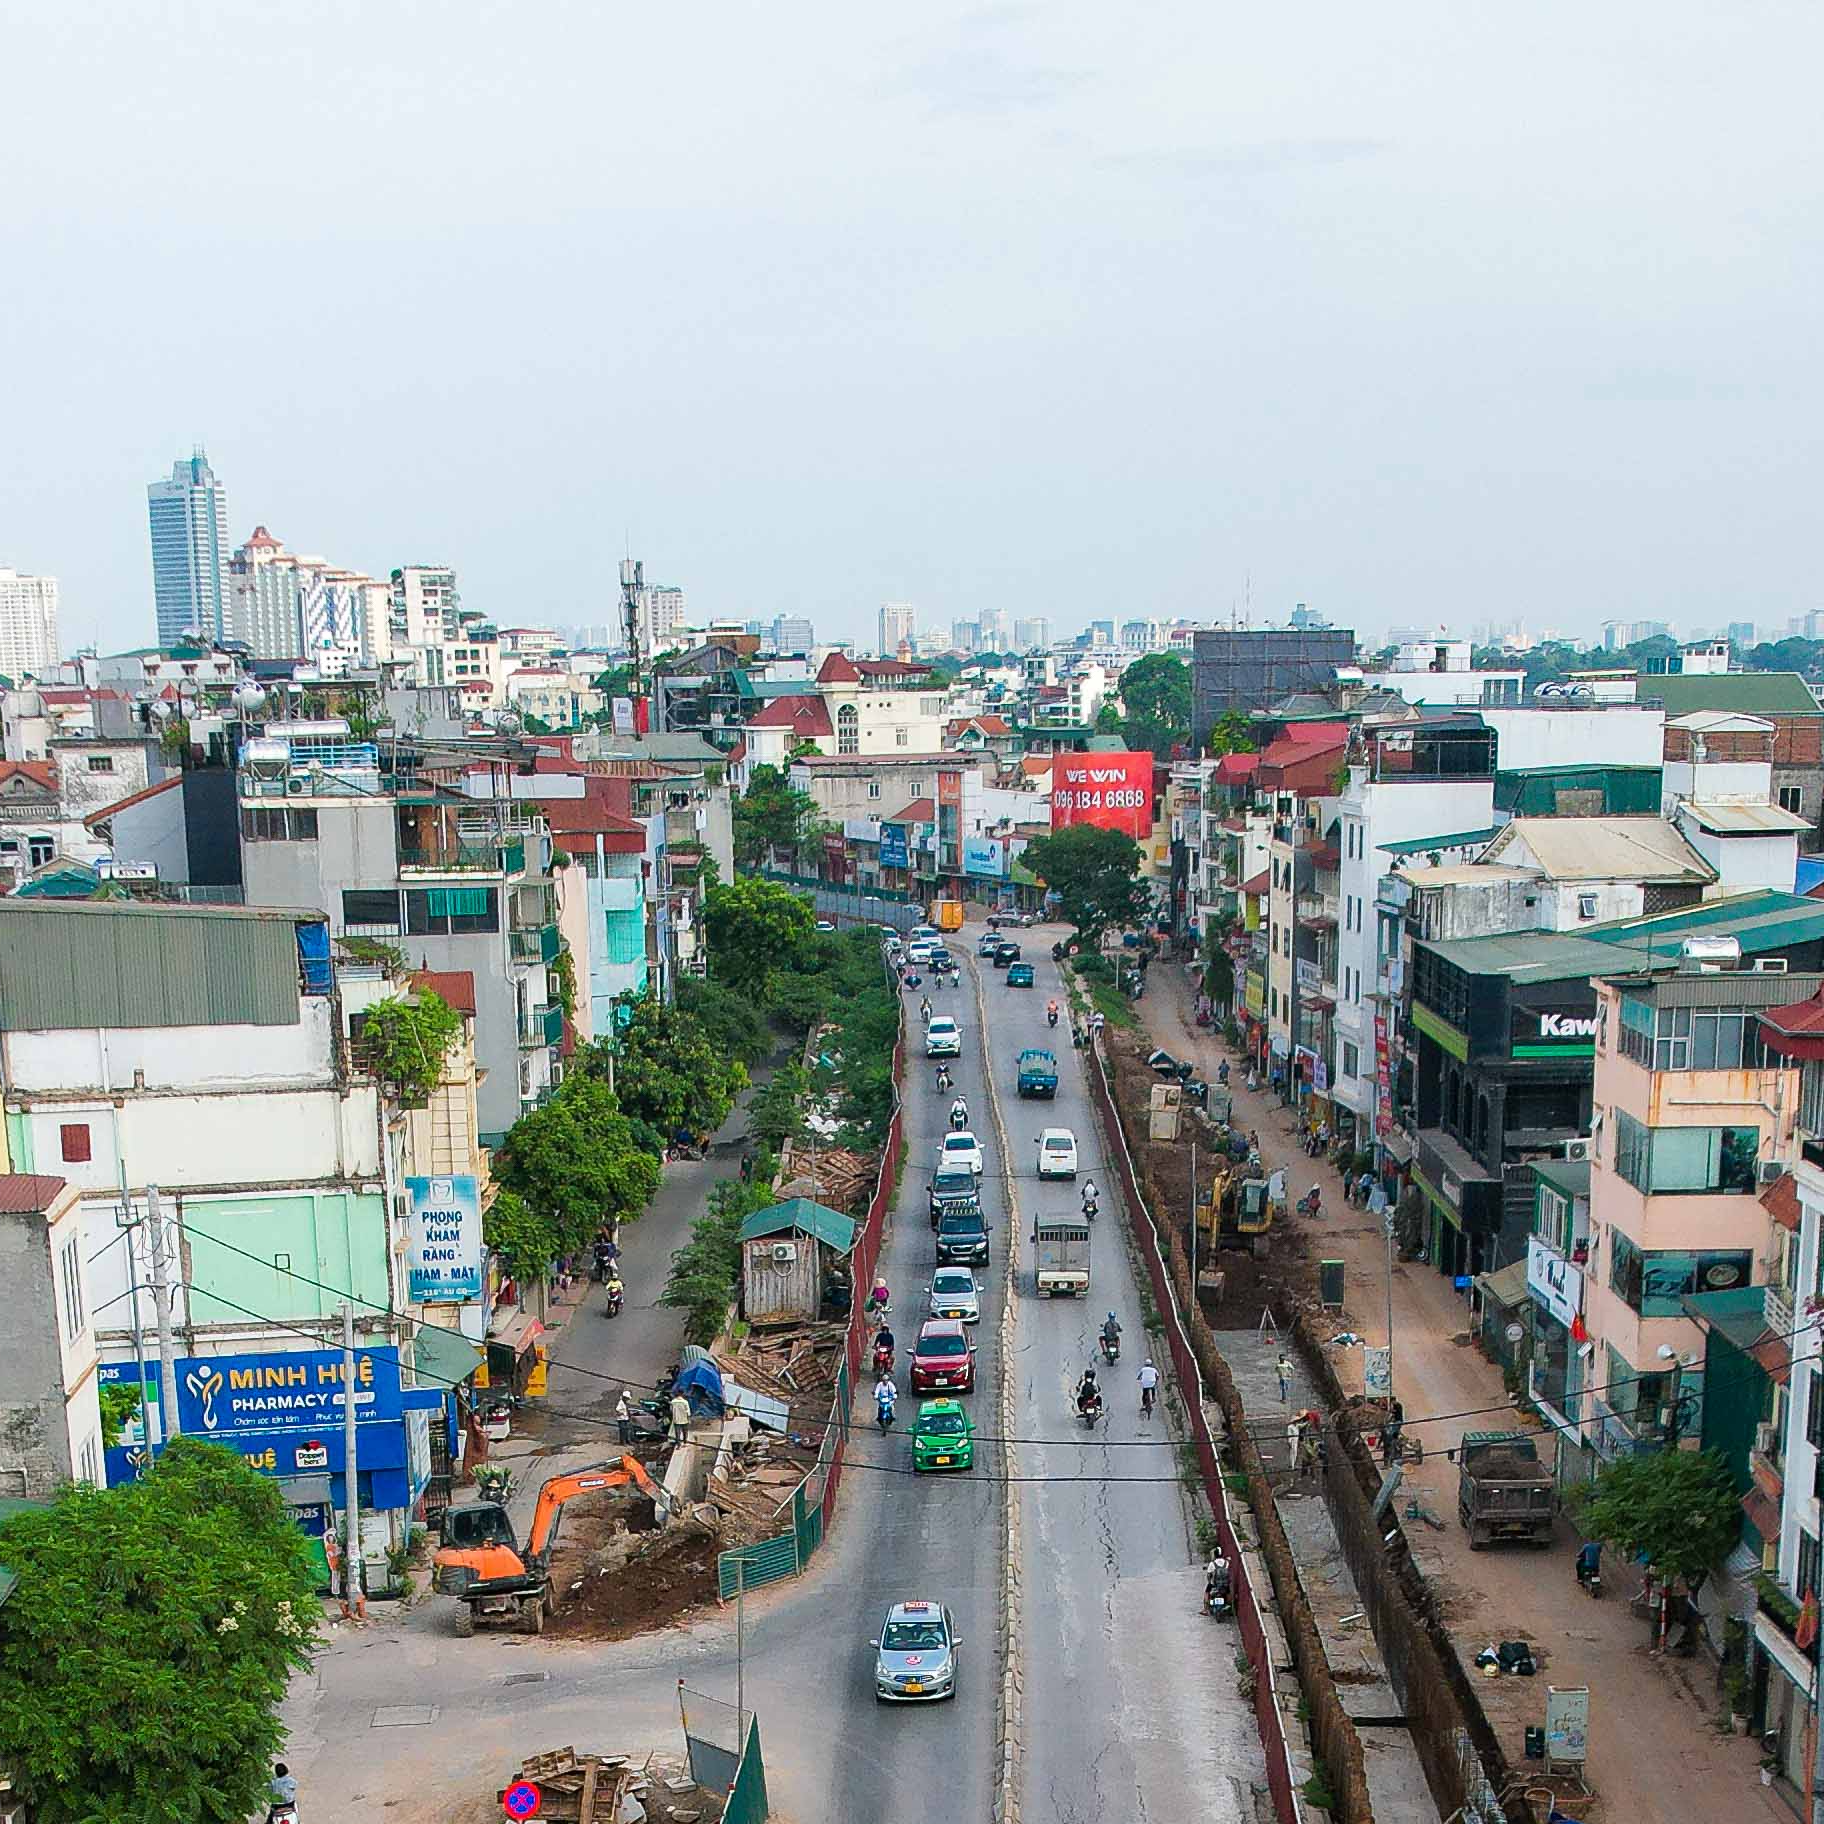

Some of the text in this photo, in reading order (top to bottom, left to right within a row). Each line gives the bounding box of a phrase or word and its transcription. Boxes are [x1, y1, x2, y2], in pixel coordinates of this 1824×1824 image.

[1066, 768, 1127, 783] WE WIN
[1055, 789, 1145, 809] 096 184 6868
[229, 1365, 307, 1390] MINH
[232, 1393, 329, 1412] PHARMACY
